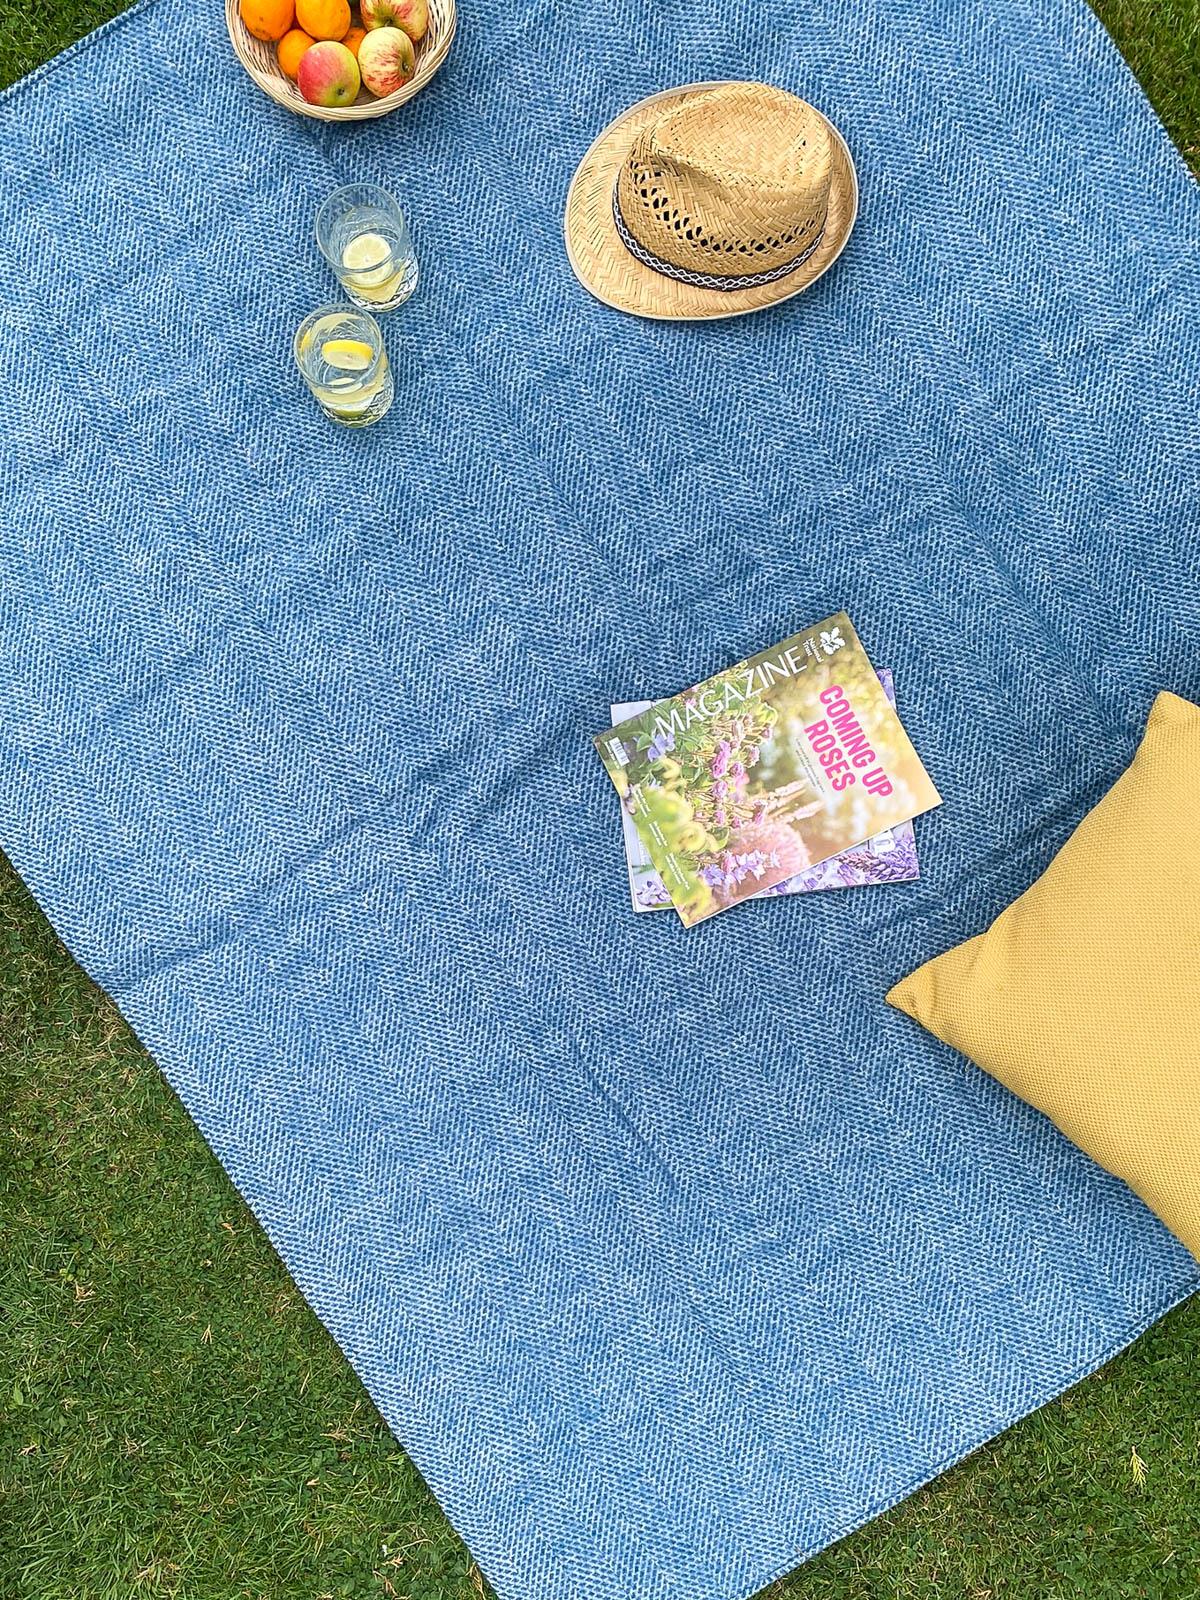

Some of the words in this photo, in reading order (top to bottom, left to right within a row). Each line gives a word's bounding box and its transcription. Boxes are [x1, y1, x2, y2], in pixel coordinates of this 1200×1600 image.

[801, 639, 814, 657] Trust
[807, 636, 825, 663] National
[654, 646, 807, 739] MAGAZINE
[804, 719, 856, 791] ROSES
[819, 685, 876, 768] COMING
[862, 767, 893, 797] UP
